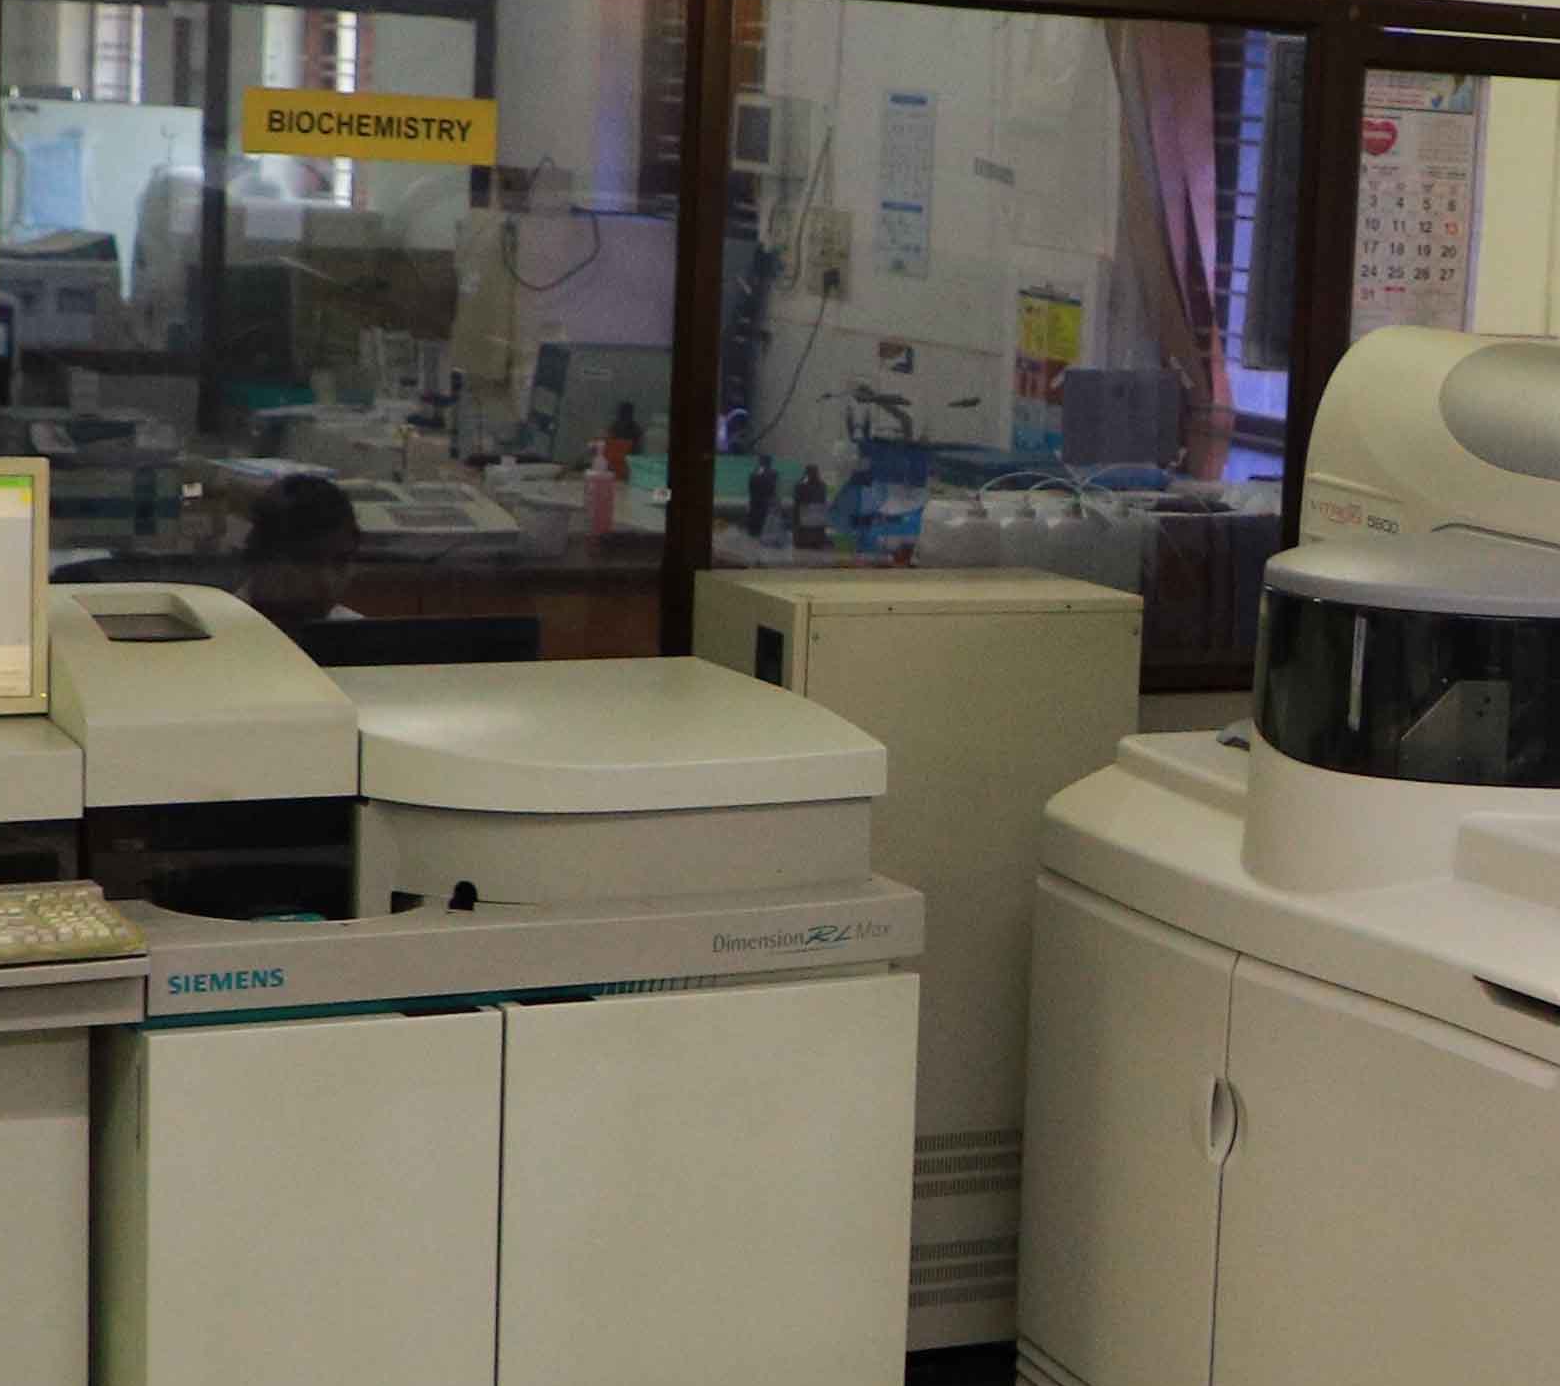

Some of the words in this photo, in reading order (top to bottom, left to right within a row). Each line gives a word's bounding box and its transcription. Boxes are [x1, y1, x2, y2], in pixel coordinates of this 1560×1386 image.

[267, 109, 474, 143] BIOCHEMISTRY
[1396, 197, 1405, 209] 4
[1423, 199, 1432, 212] 5
[1365, 218, 1381, 232] 10
[1393, 220, 1407, 233] 11
[1419, 221, 1433, 234] 12
[1362, 240, 1379, 254] 17
[1390, 242, 1405, 256] 18
[1417, 244, 1432, 257] 19
[1441, 245, 1457, 258] 20
[1360, 264, 1377, 278] 24
[1388, 266, 1405, 279] 25
[1414, 267, 1431, 280] 26
[1440, 268, 1455, 281] 27
[712, 929, 805, 952] Dimension
[168, 968, 285, 995] SIEMENS
